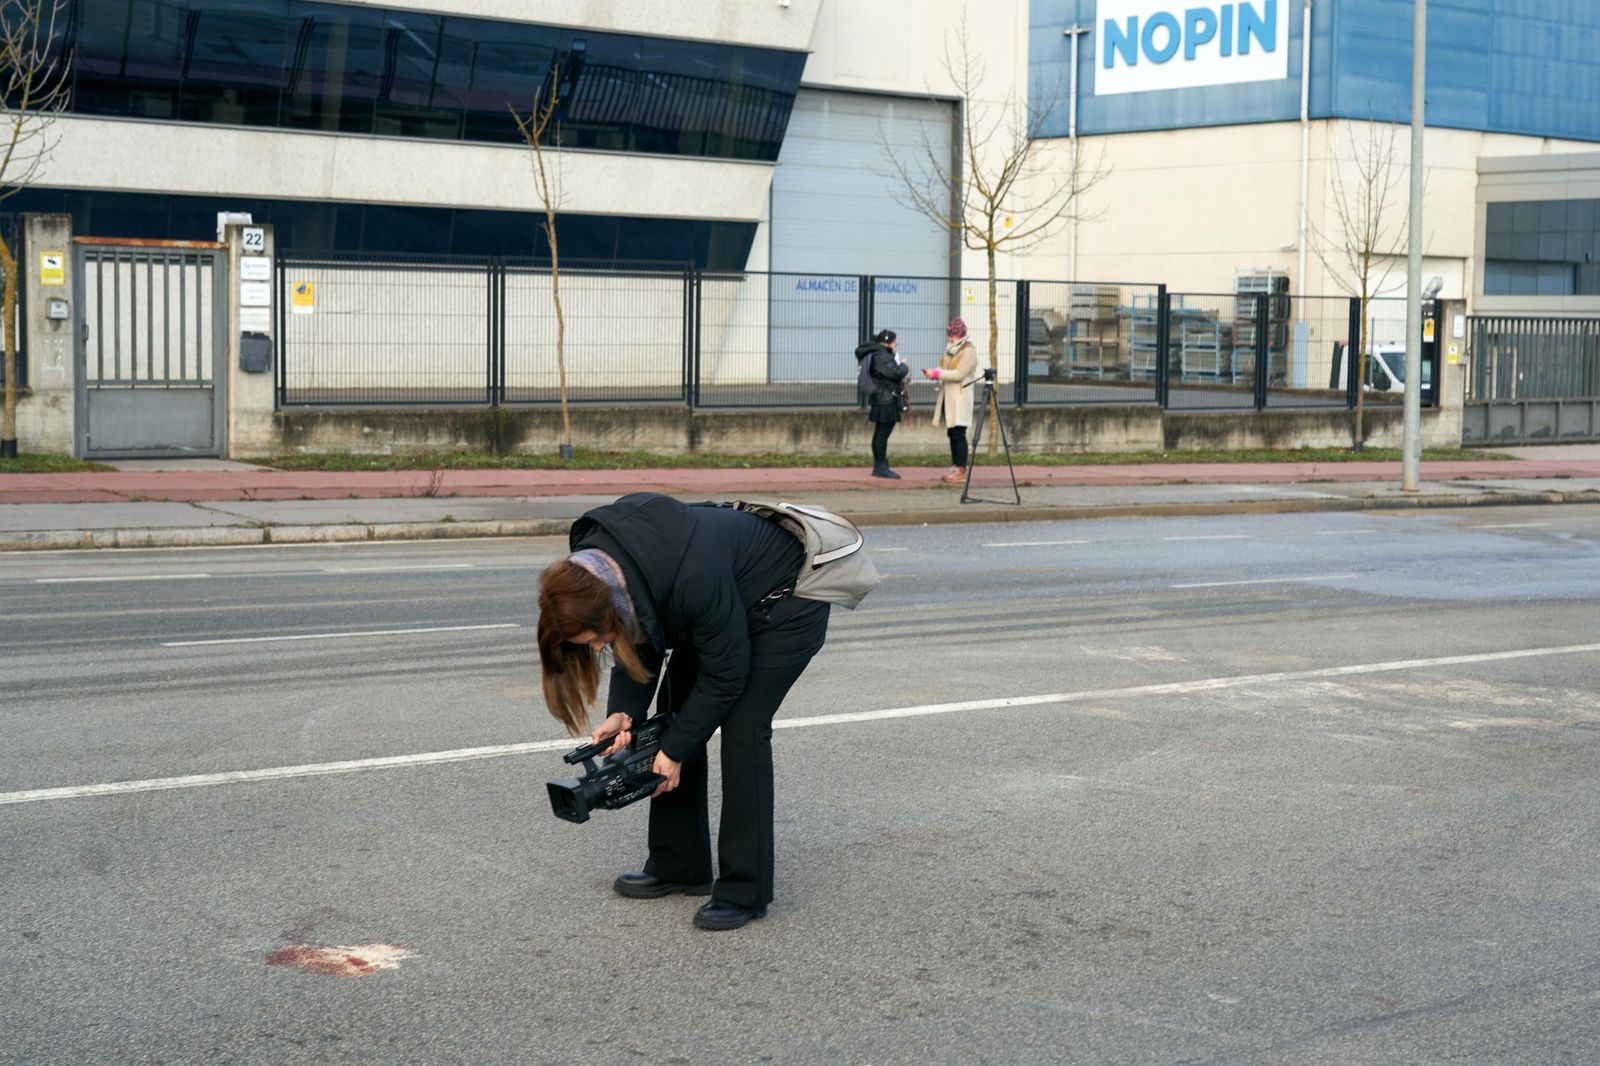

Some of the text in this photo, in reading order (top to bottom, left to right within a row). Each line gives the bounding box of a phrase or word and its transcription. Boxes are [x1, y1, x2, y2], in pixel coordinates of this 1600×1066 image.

[1103, 0, 1277, 69] NOPIN
[246, 233, 262, 246] 22
[844, 281, 857, 293] DE
